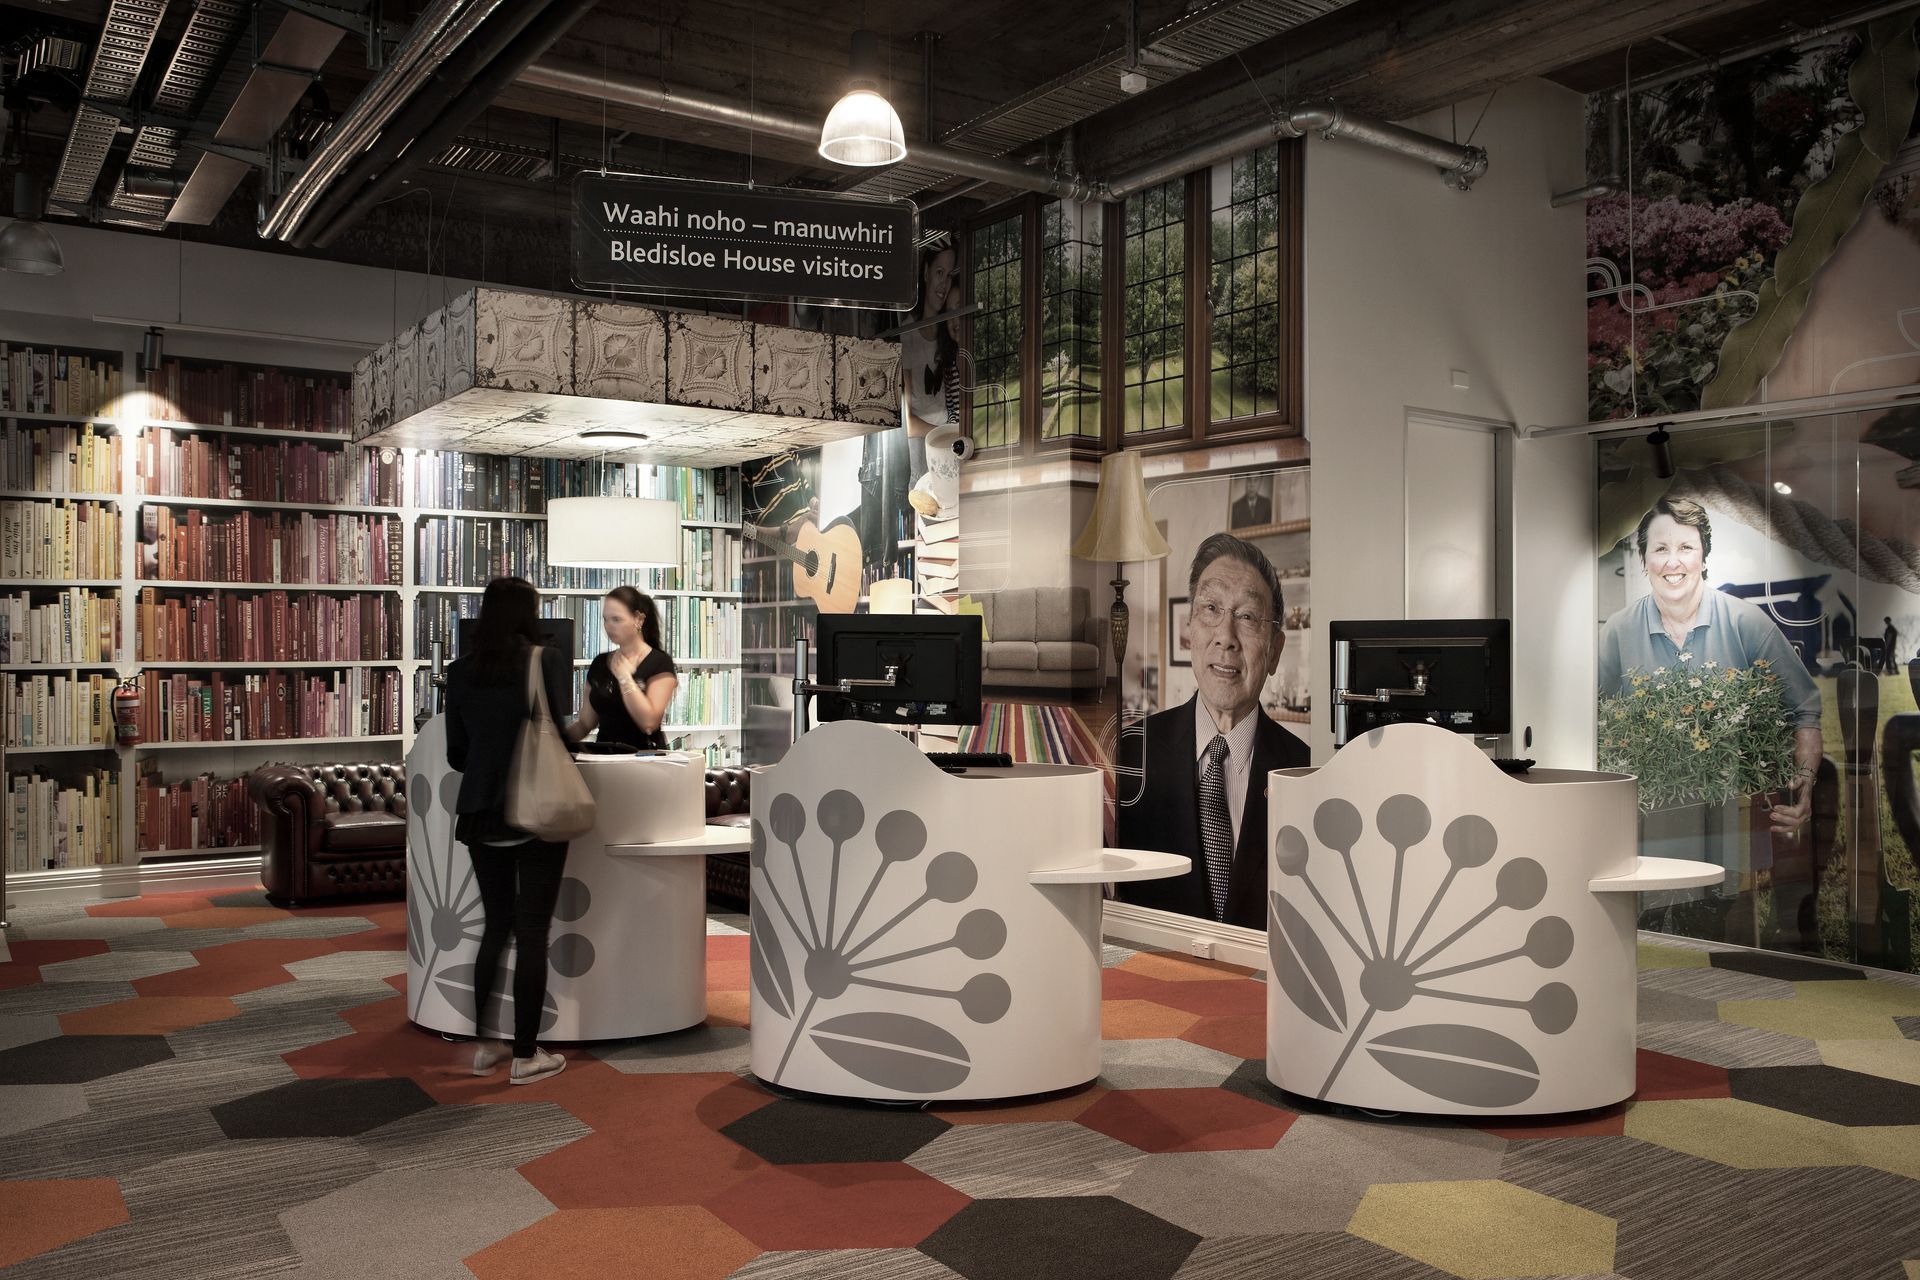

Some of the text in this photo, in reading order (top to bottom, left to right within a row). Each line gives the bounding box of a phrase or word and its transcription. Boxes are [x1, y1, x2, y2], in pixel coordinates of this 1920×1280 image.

[603, 202, 679, 228] Waahi
[688, 209, 746, 233] noho
[774, 219, 894, 245] manuwhiri
[611, 240, 884, 280] Bledisloe House visitors
[4, 517, 12, 559] and Sword
[63, 594, 71, 619] LEEDS
[204, 697, 212, 729] ITALIAN
